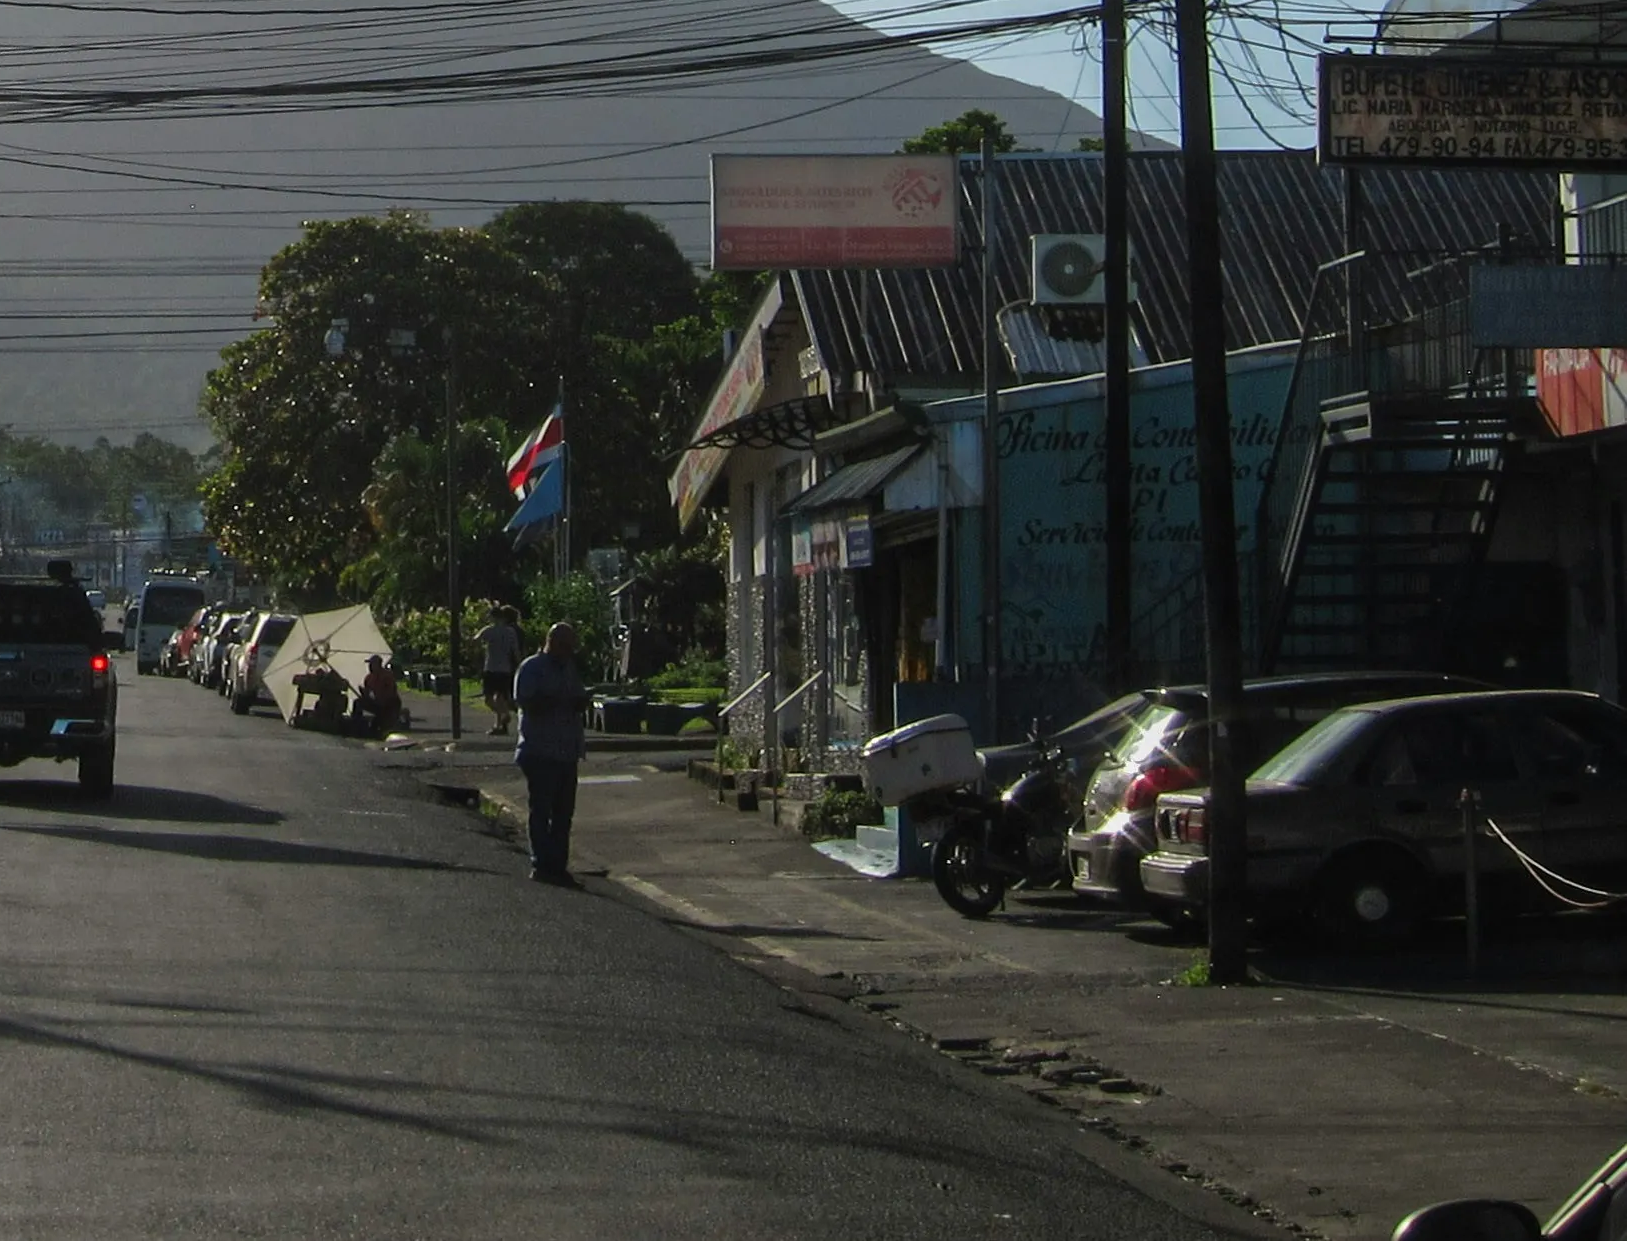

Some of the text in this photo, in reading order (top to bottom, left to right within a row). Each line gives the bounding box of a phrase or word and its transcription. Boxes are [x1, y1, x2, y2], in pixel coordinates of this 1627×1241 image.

[1437, 70, 1532, 98] JIMENEZ
[1537, 70, 1562, 98] &
[1388, 119, 1452, 134] ABOGADA
